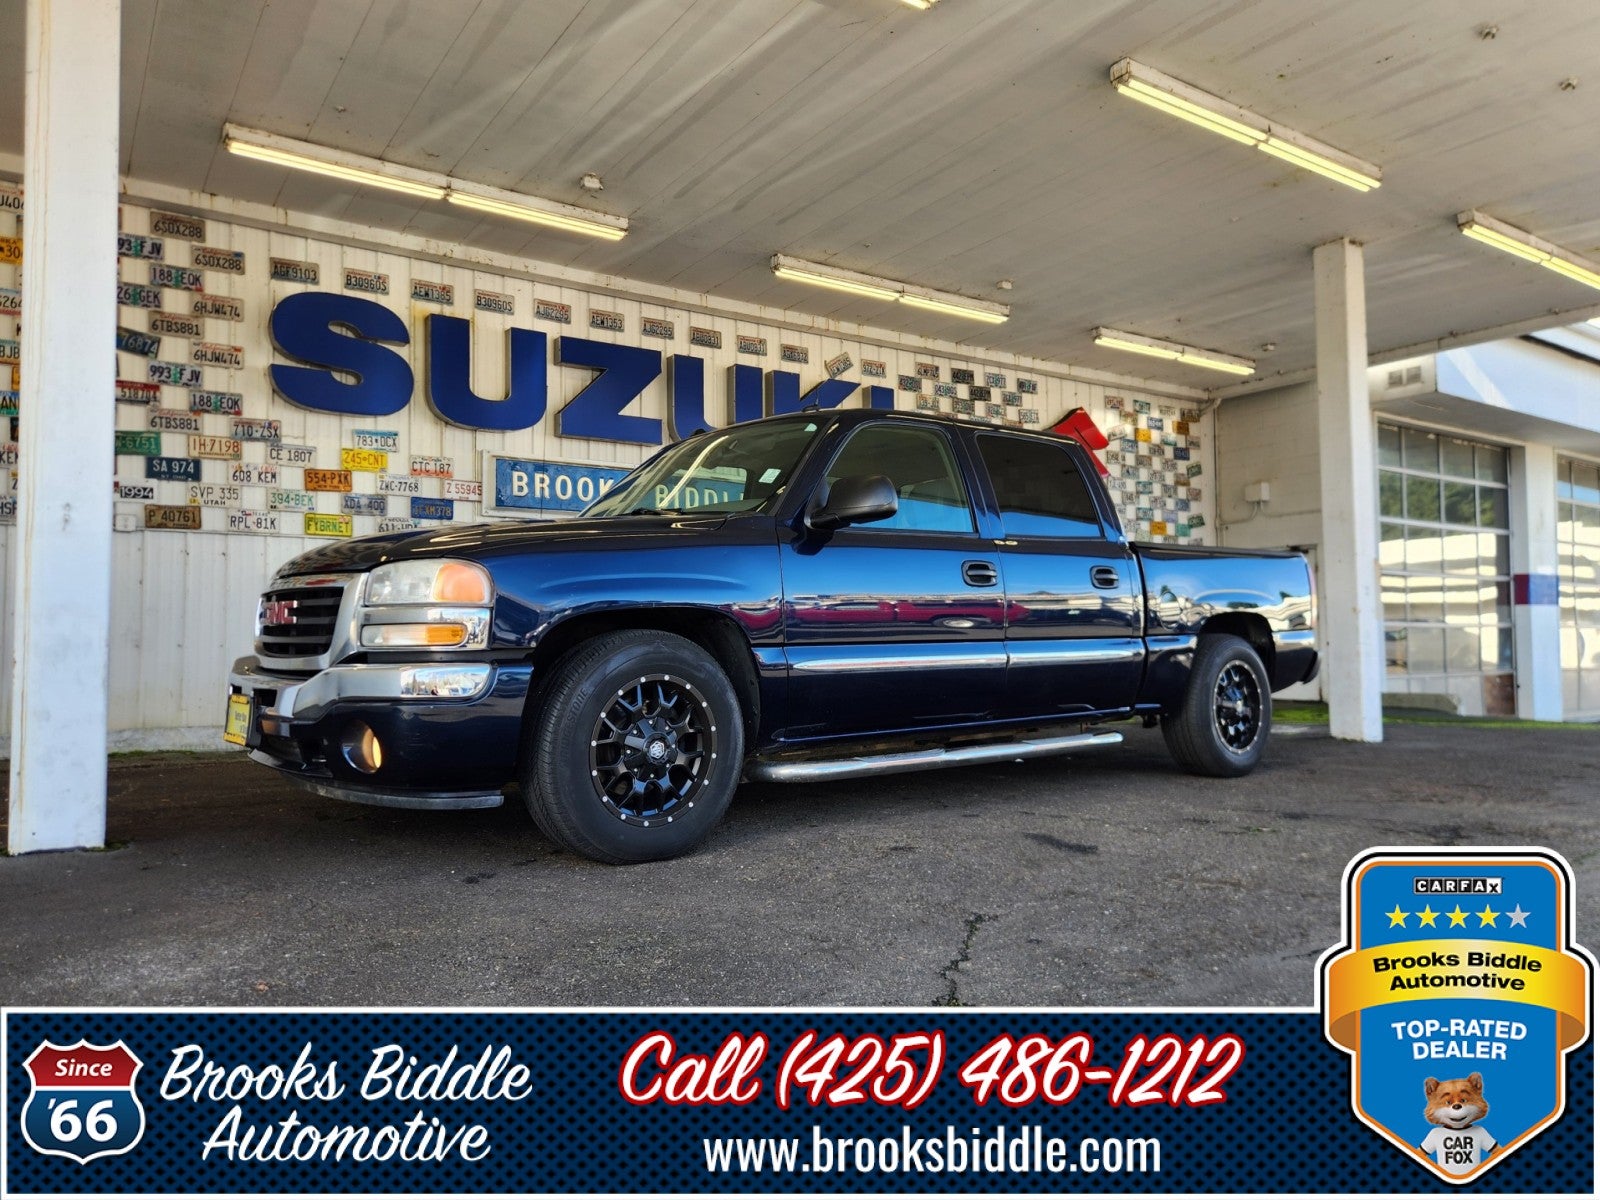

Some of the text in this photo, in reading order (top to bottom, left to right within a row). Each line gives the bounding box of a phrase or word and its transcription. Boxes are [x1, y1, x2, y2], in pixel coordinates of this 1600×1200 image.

[152, 267, 173, 282] 188
[193, 301, 240, 317] 6HJW474
[152, 319, 201, 336] 6TBS881
[193, 349, 240, 365] 6HJW474
[149, 365, 172, 379] 993
[192, 393, 212, 407] 188
[150, 416, 200, 431] 6TBS881
[270, 448, 312, 463] CE 1807
[153, 460, 194, 473] SA 974
[411, 461, 430, 472] CTC
[232, 470, 277, 483] 608 KEM
[120, 486, 154, 499] 1994
[190, 486, 239, 500] SVP 335
[446, 482, 452, 493] Z
[512, 471, 614, 501] BROOK
[148, 509, 196, 524] P 40761
[230, 515, 277, 530] RPL 81K
